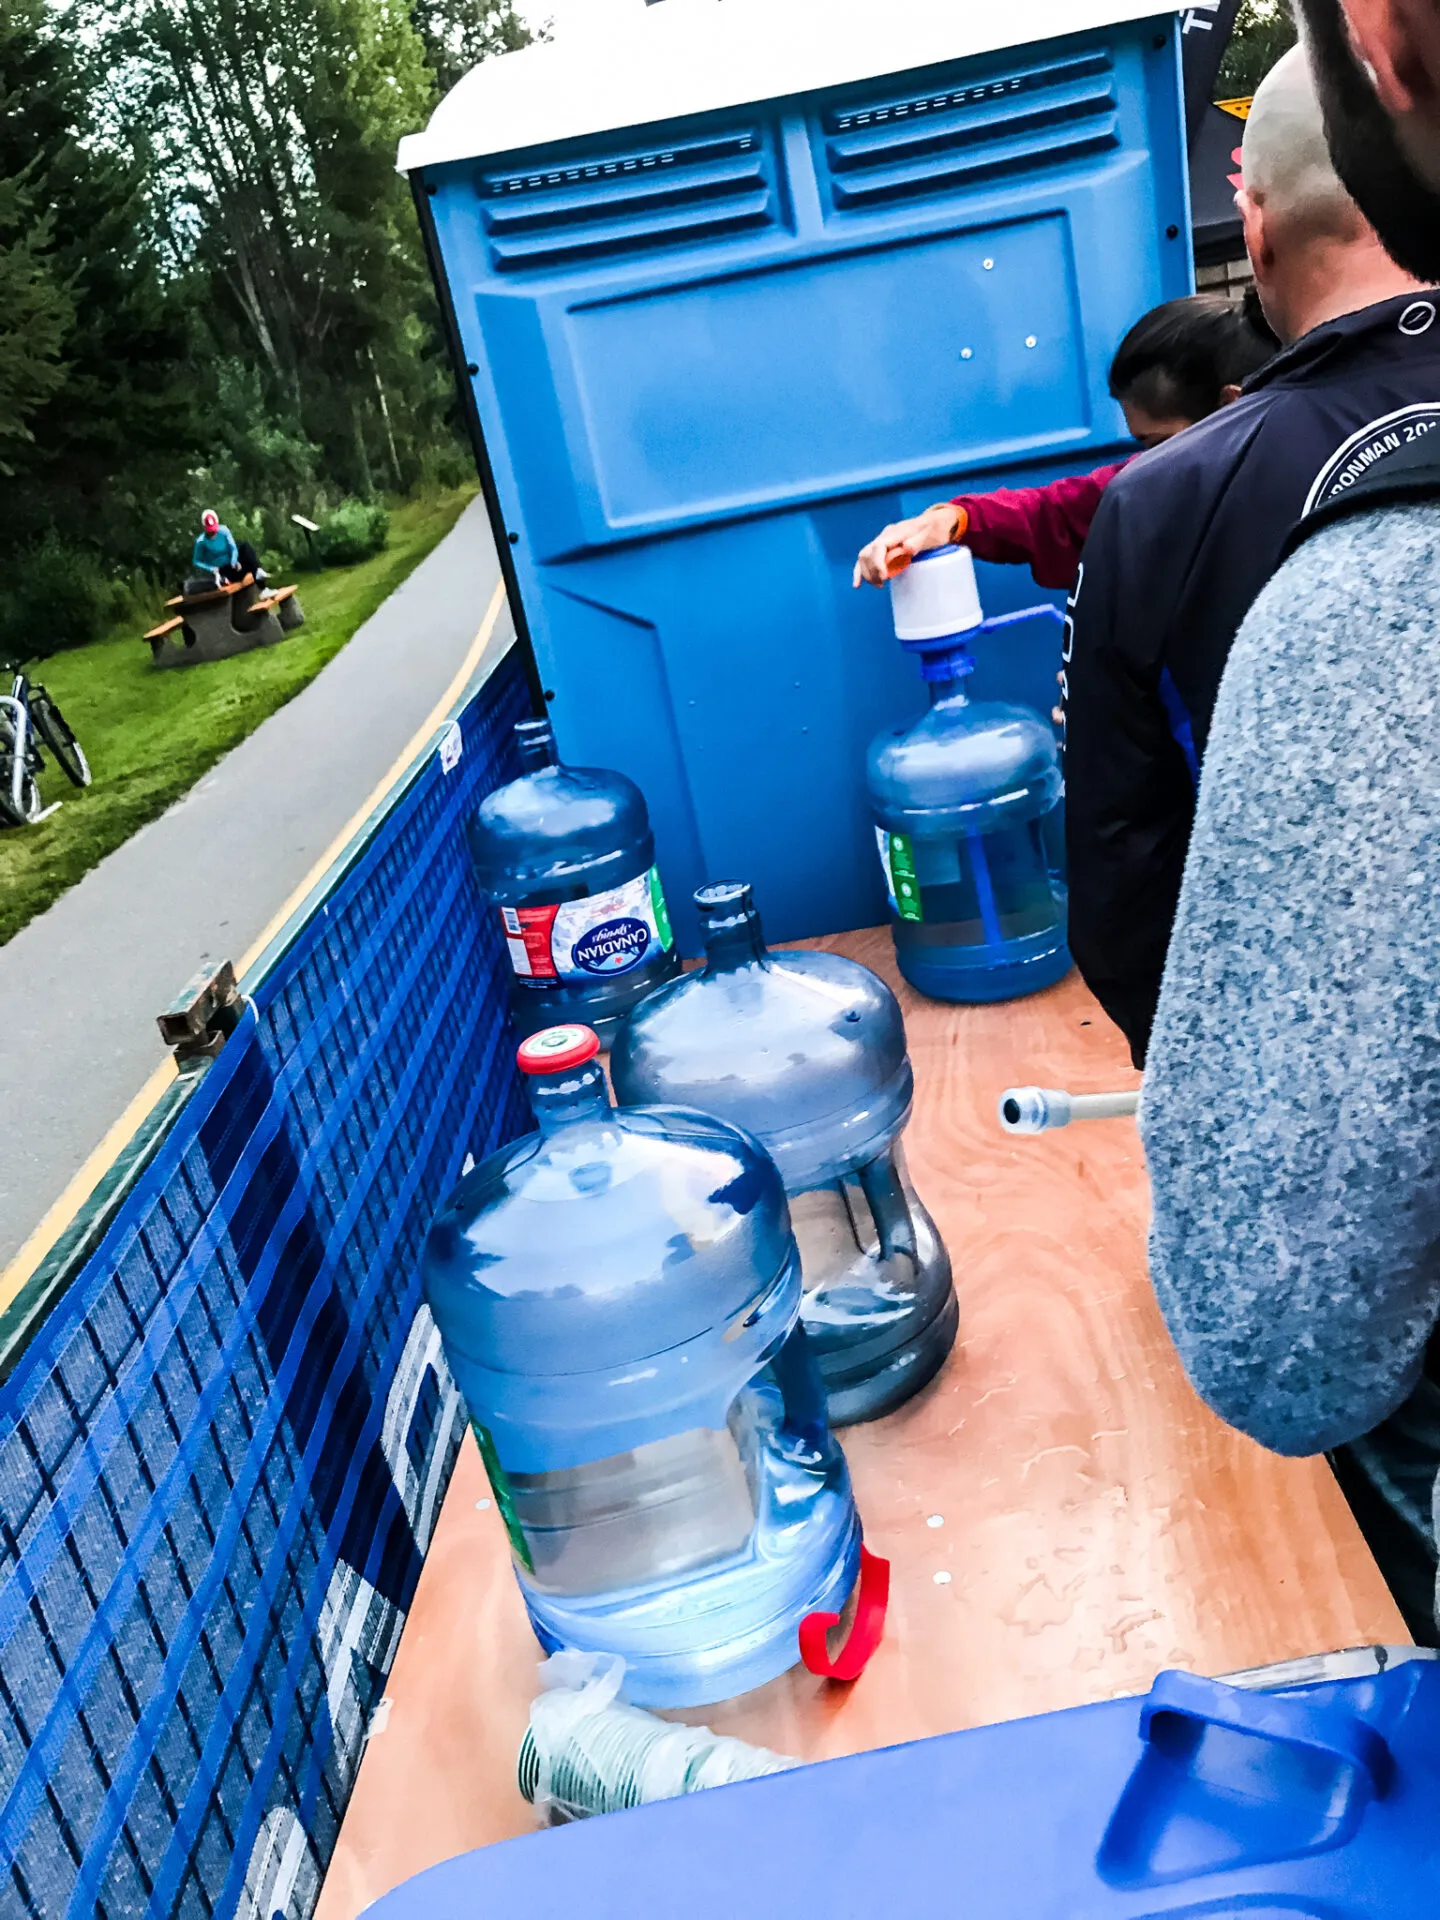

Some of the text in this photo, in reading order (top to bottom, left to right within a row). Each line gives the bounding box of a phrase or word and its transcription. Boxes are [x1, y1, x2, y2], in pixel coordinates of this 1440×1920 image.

[1327, 421, 1437, 499] RONMAN 20
[578, 928, 648, 962] CANADIAN
